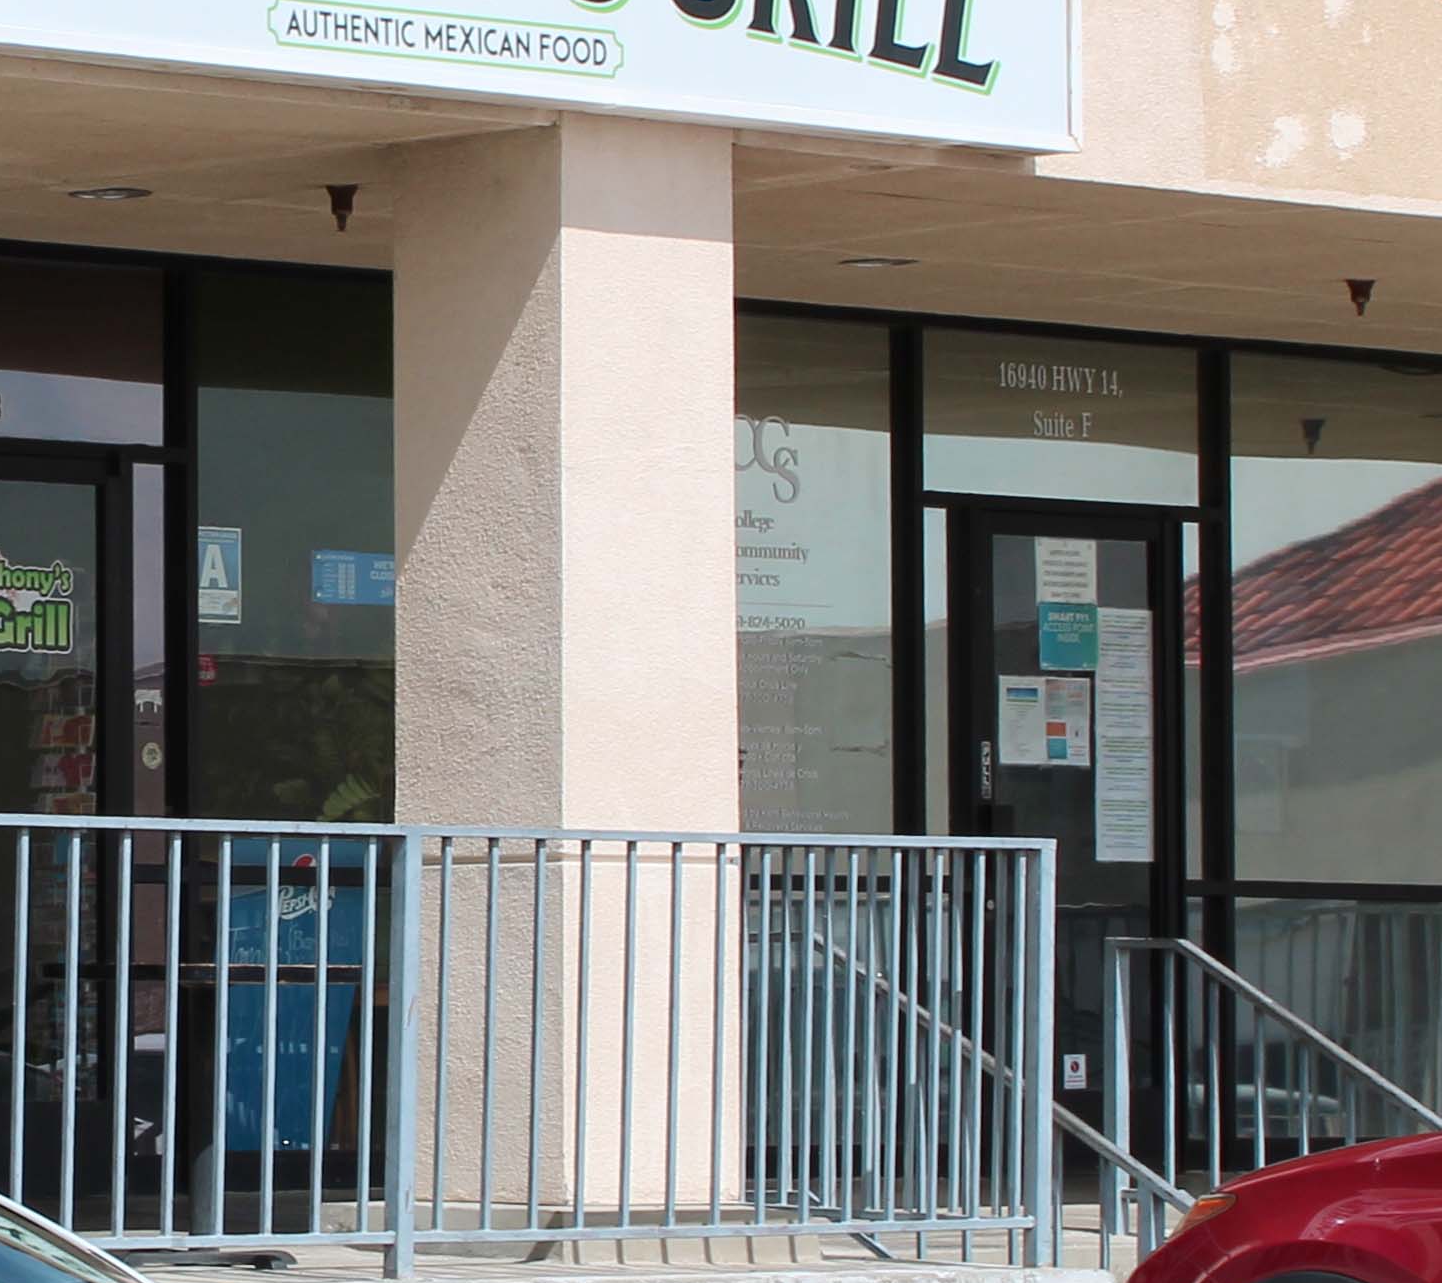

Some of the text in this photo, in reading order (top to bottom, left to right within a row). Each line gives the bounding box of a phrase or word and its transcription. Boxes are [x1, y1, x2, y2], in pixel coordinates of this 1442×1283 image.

[287, 9, 608, 67] AUTHENTIC MEXICAN FOOD
[999, 361, 1123, 399] 16940 HWY 14,
[1033, 409, 1092, 438] Suite F
[736, 509, 774, 533] ollege
[200, 543, 229, 588] A
[736, 541, 809, 564] ommunity
